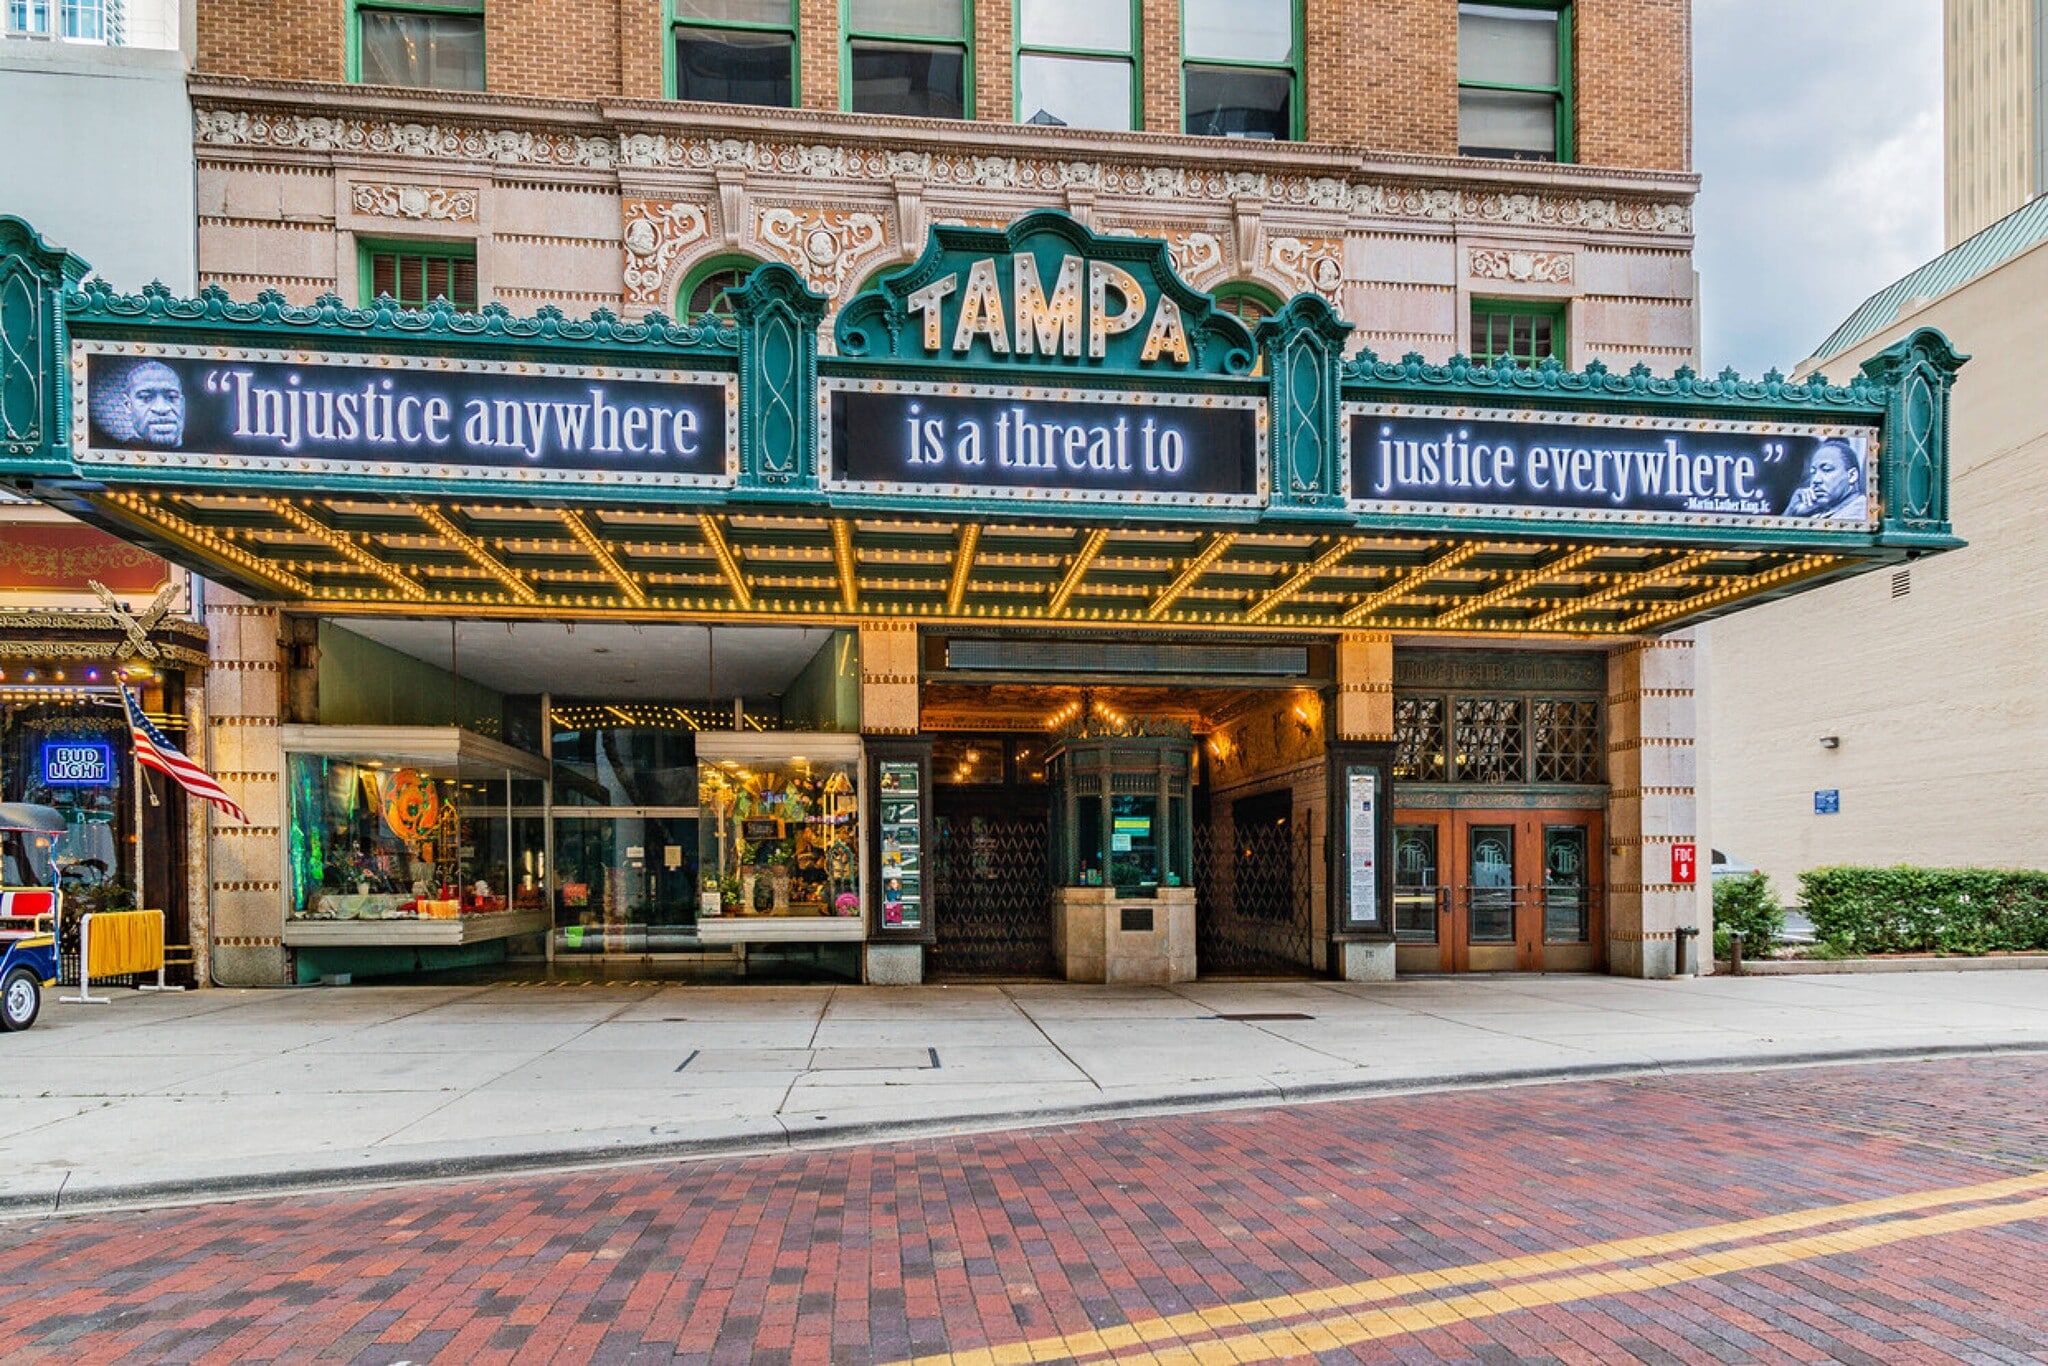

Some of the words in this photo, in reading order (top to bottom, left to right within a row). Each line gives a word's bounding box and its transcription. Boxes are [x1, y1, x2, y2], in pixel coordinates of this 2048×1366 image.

[907, 252, 1190, 364] TAMPA
[206, 370, 450, 448] “Injustice
[463, 389, 699, 458] anywhere
[907, 404, 944, 464] is
[957, 420, 985, 466] a
[995, 407, 1132, 471] threat
[1142, 418, 1184, 473] to
[1375, 427, 1515, 492] justice
[49, 762, 105, 779] LIGHT
[57, 748, 98, 763] BUD
[1674, 848, 1693, 862] FDC
